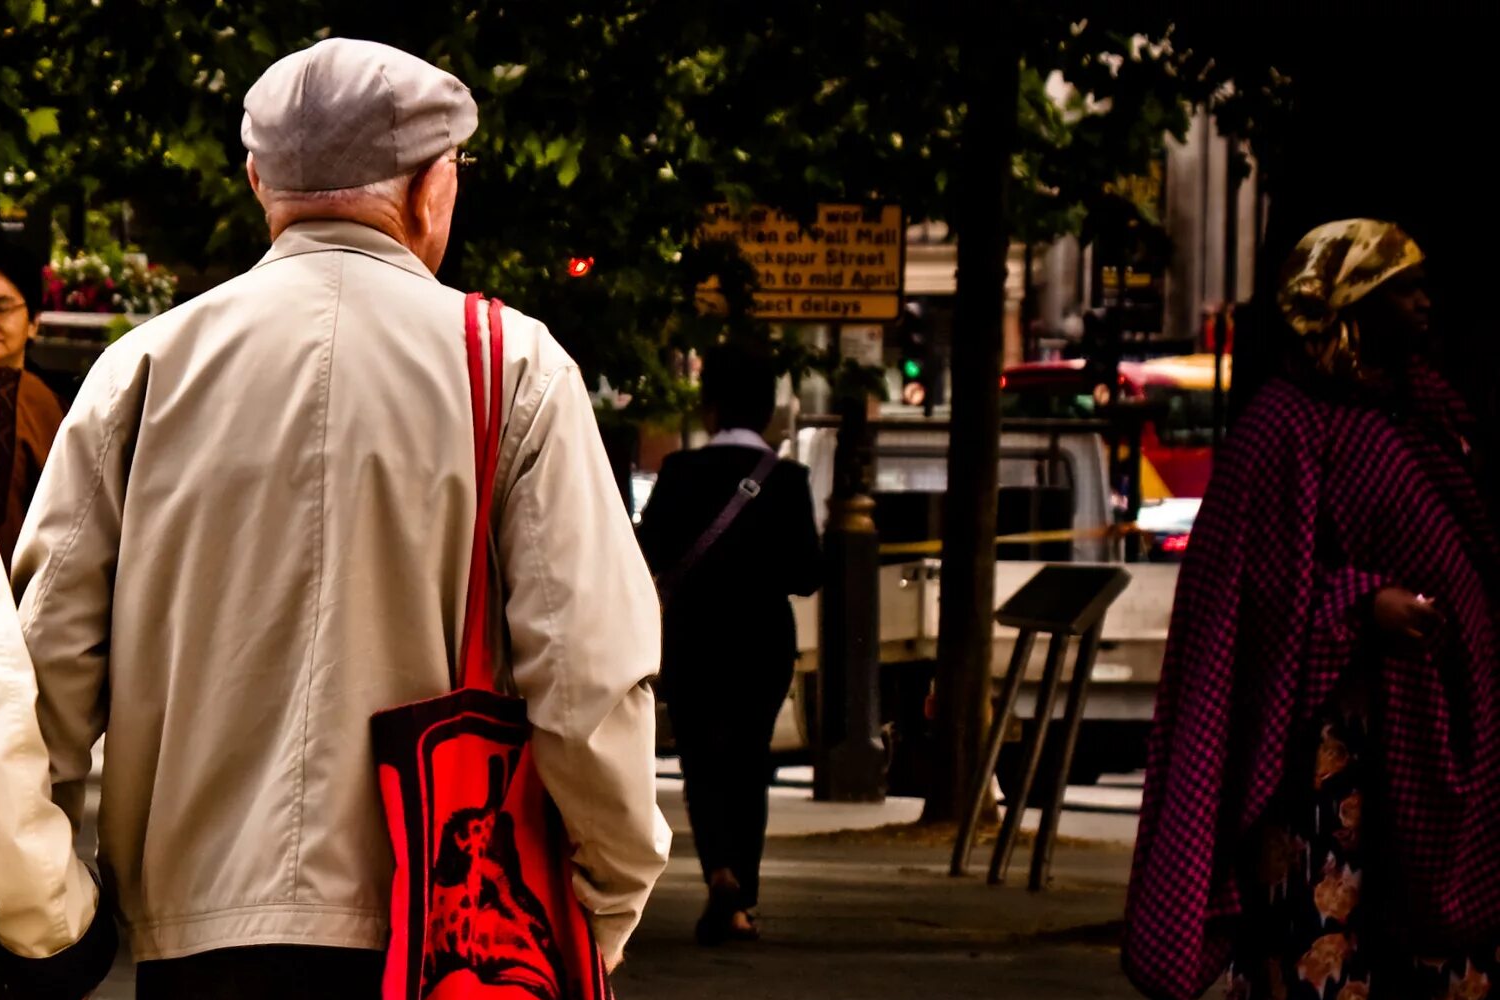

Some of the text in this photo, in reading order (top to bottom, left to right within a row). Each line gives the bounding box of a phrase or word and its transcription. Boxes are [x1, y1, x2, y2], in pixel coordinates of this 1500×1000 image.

[856, 227, 897, 244] Mall
[825, 249, 885, 266] Street
[783, 272, 802, 285] to
[809, 271, 843, 285] mid
[852, 271, 897, 289] April
[800, 296, 862, 314] delays
